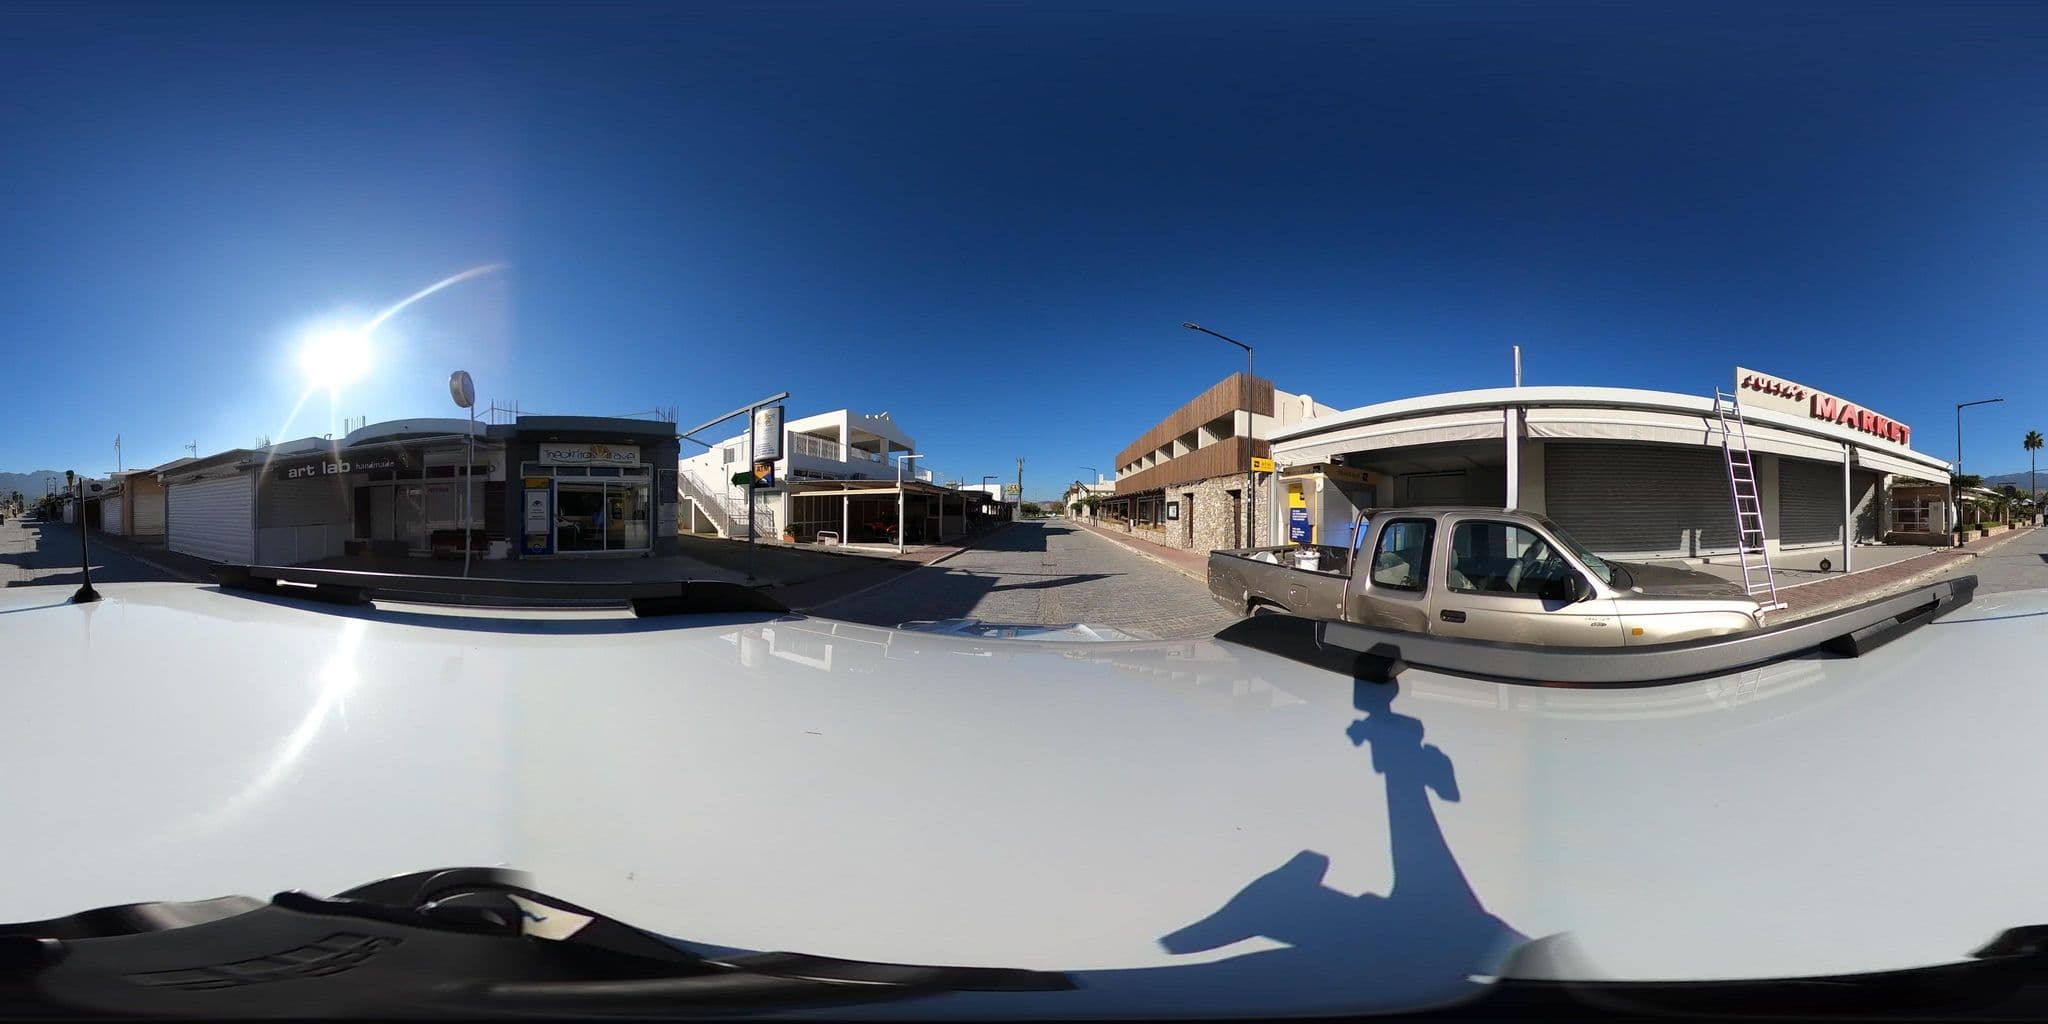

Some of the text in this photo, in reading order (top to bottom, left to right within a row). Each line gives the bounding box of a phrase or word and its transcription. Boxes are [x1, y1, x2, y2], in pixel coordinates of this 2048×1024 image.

[1810, 393, 1911, 445] MARKET
[287, 464, 315, 478] art
[322, 459, 351, 475] lab
[756, 464, 769, 473] ATM
